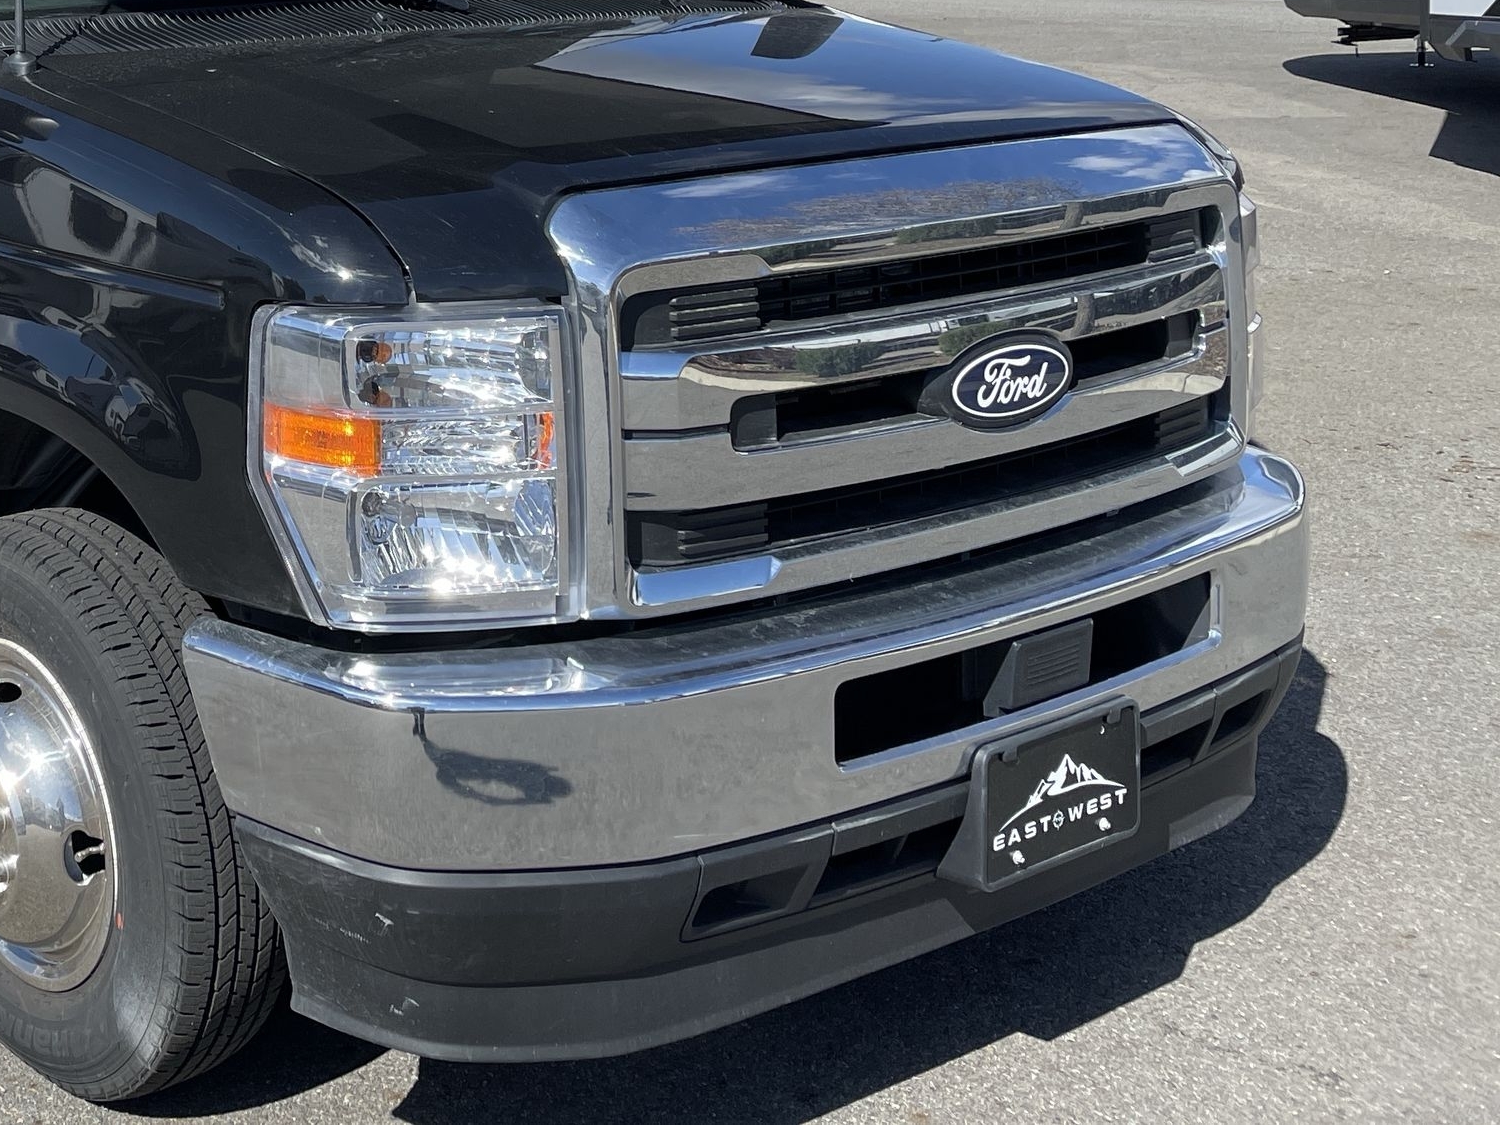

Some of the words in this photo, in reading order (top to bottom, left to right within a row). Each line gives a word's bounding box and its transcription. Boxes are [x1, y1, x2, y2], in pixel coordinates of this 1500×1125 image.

[977, 354, 1049, 408] Ford
[993, 815, 1052, 852] EAST
[1067, 788, 1128, 822] WEST
